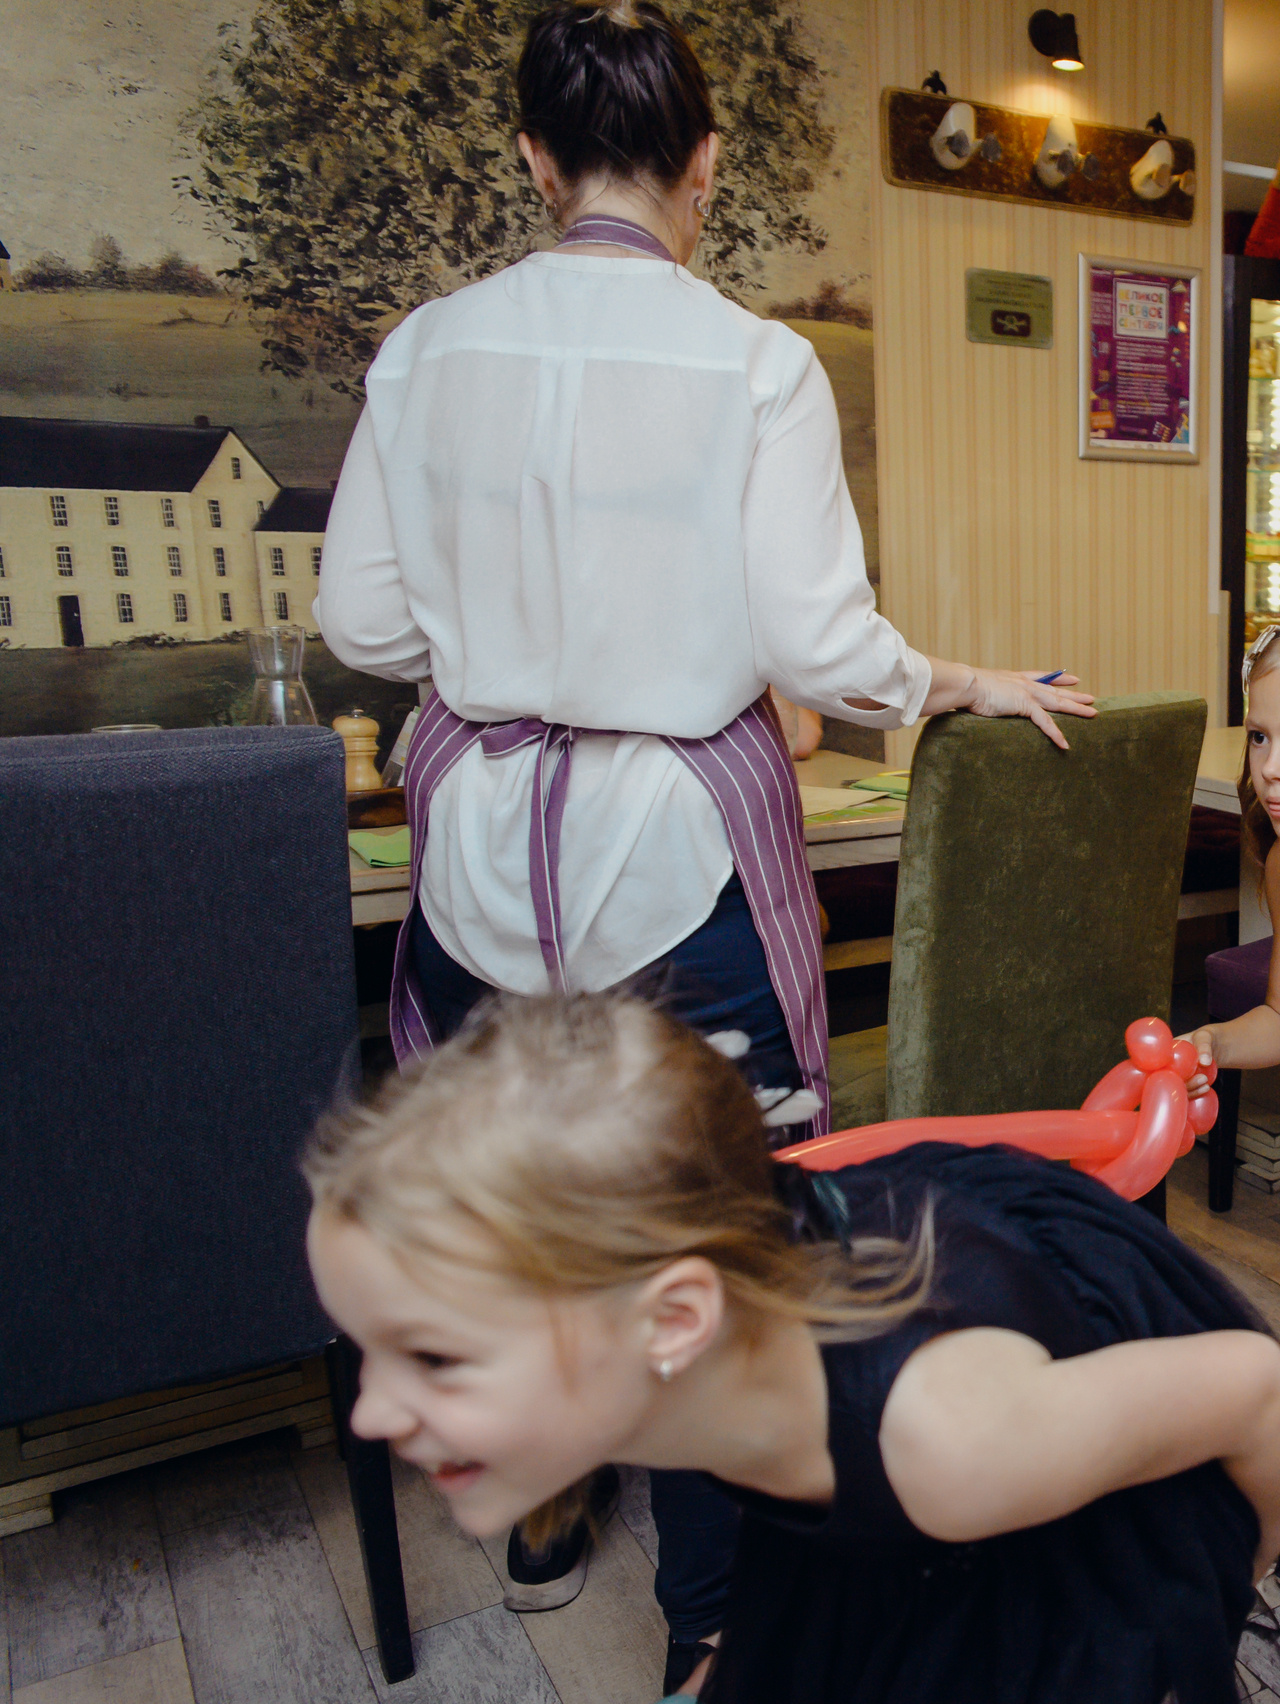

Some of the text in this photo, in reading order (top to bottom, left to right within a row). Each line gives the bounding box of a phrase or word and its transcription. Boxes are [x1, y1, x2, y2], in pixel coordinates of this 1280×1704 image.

[1118, 288, 1163, 304] ВЕЛИКОЕ
[1119, 303, 1163, 319] ПЕРВОЕ
[1118, 317, 1163, 330] СЕНТЯБРЯ
